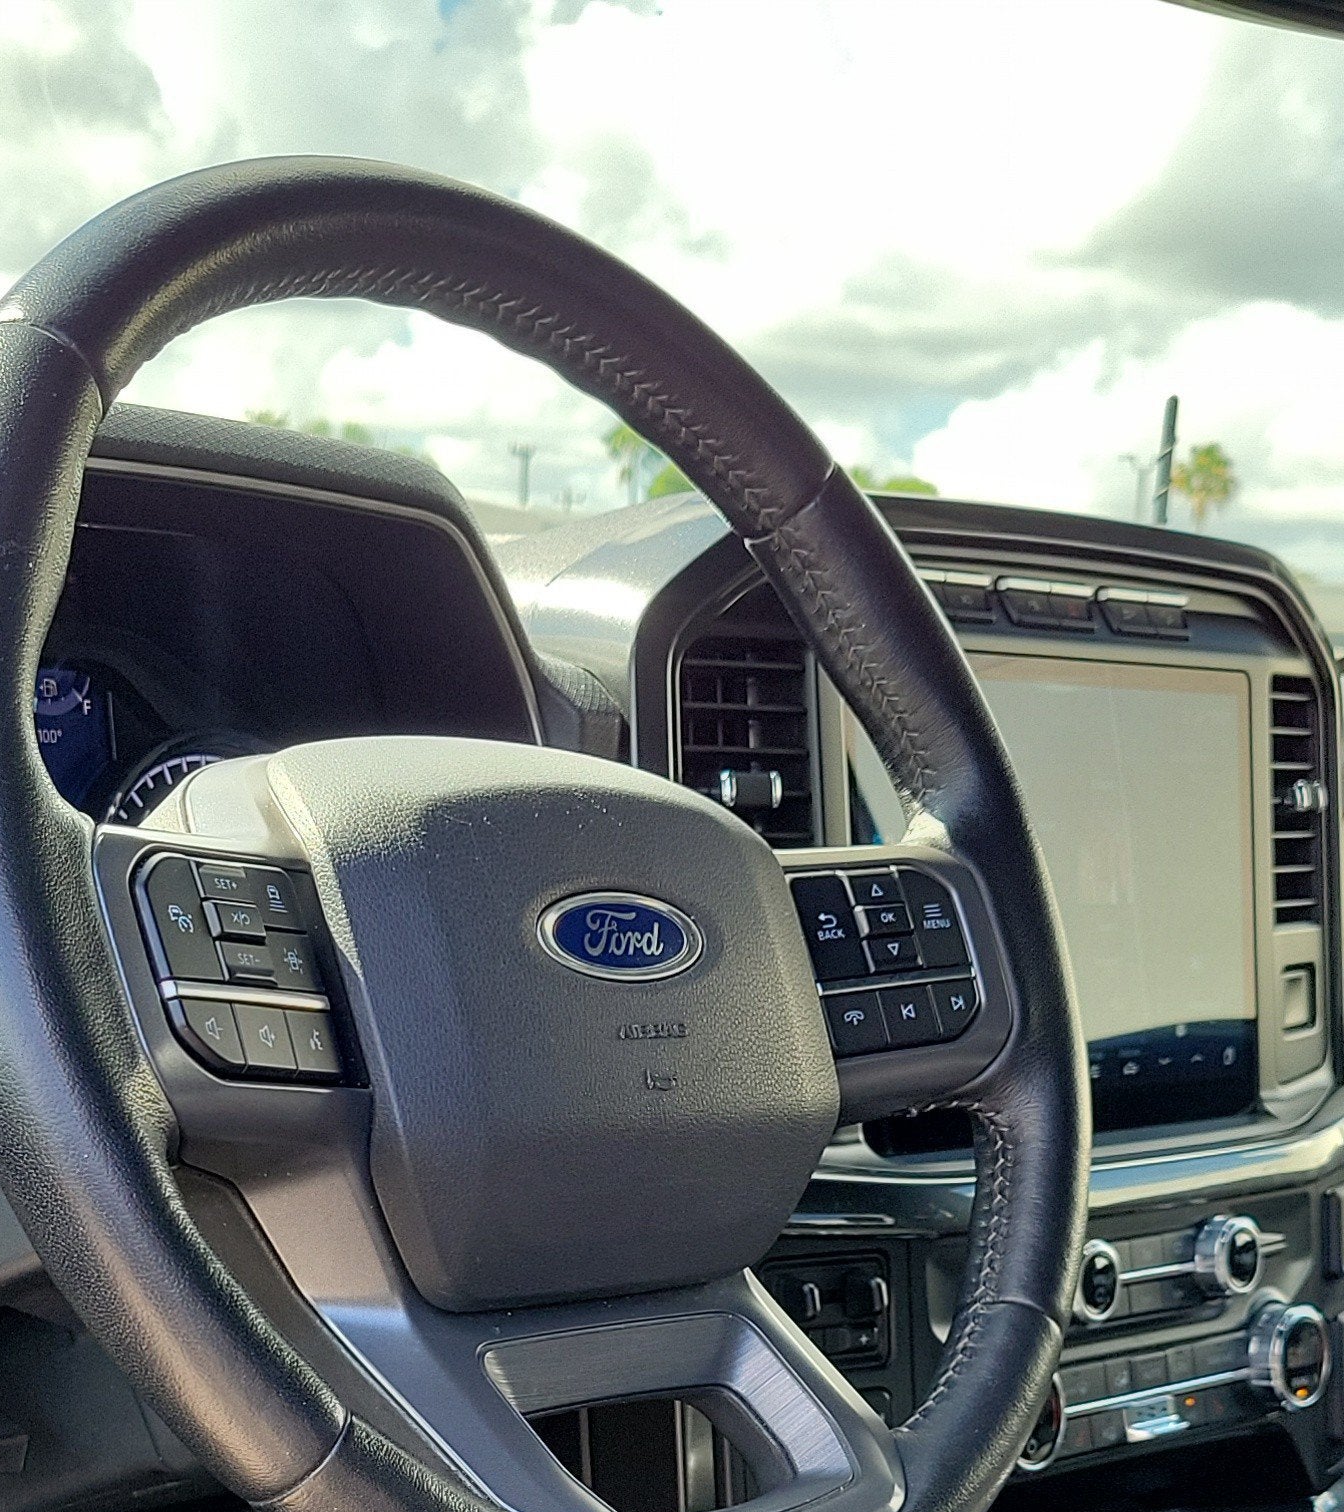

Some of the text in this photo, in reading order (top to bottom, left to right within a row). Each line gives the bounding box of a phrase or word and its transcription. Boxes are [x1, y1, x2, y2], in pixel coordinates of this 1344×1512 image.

[83, 699, 92, 716] F
[880, 911, 897, 924] OK
[923, 918, 952, 931] MENU
[583, 909, 664, 957] Ford
[816, 928, 846, 942] BACK
